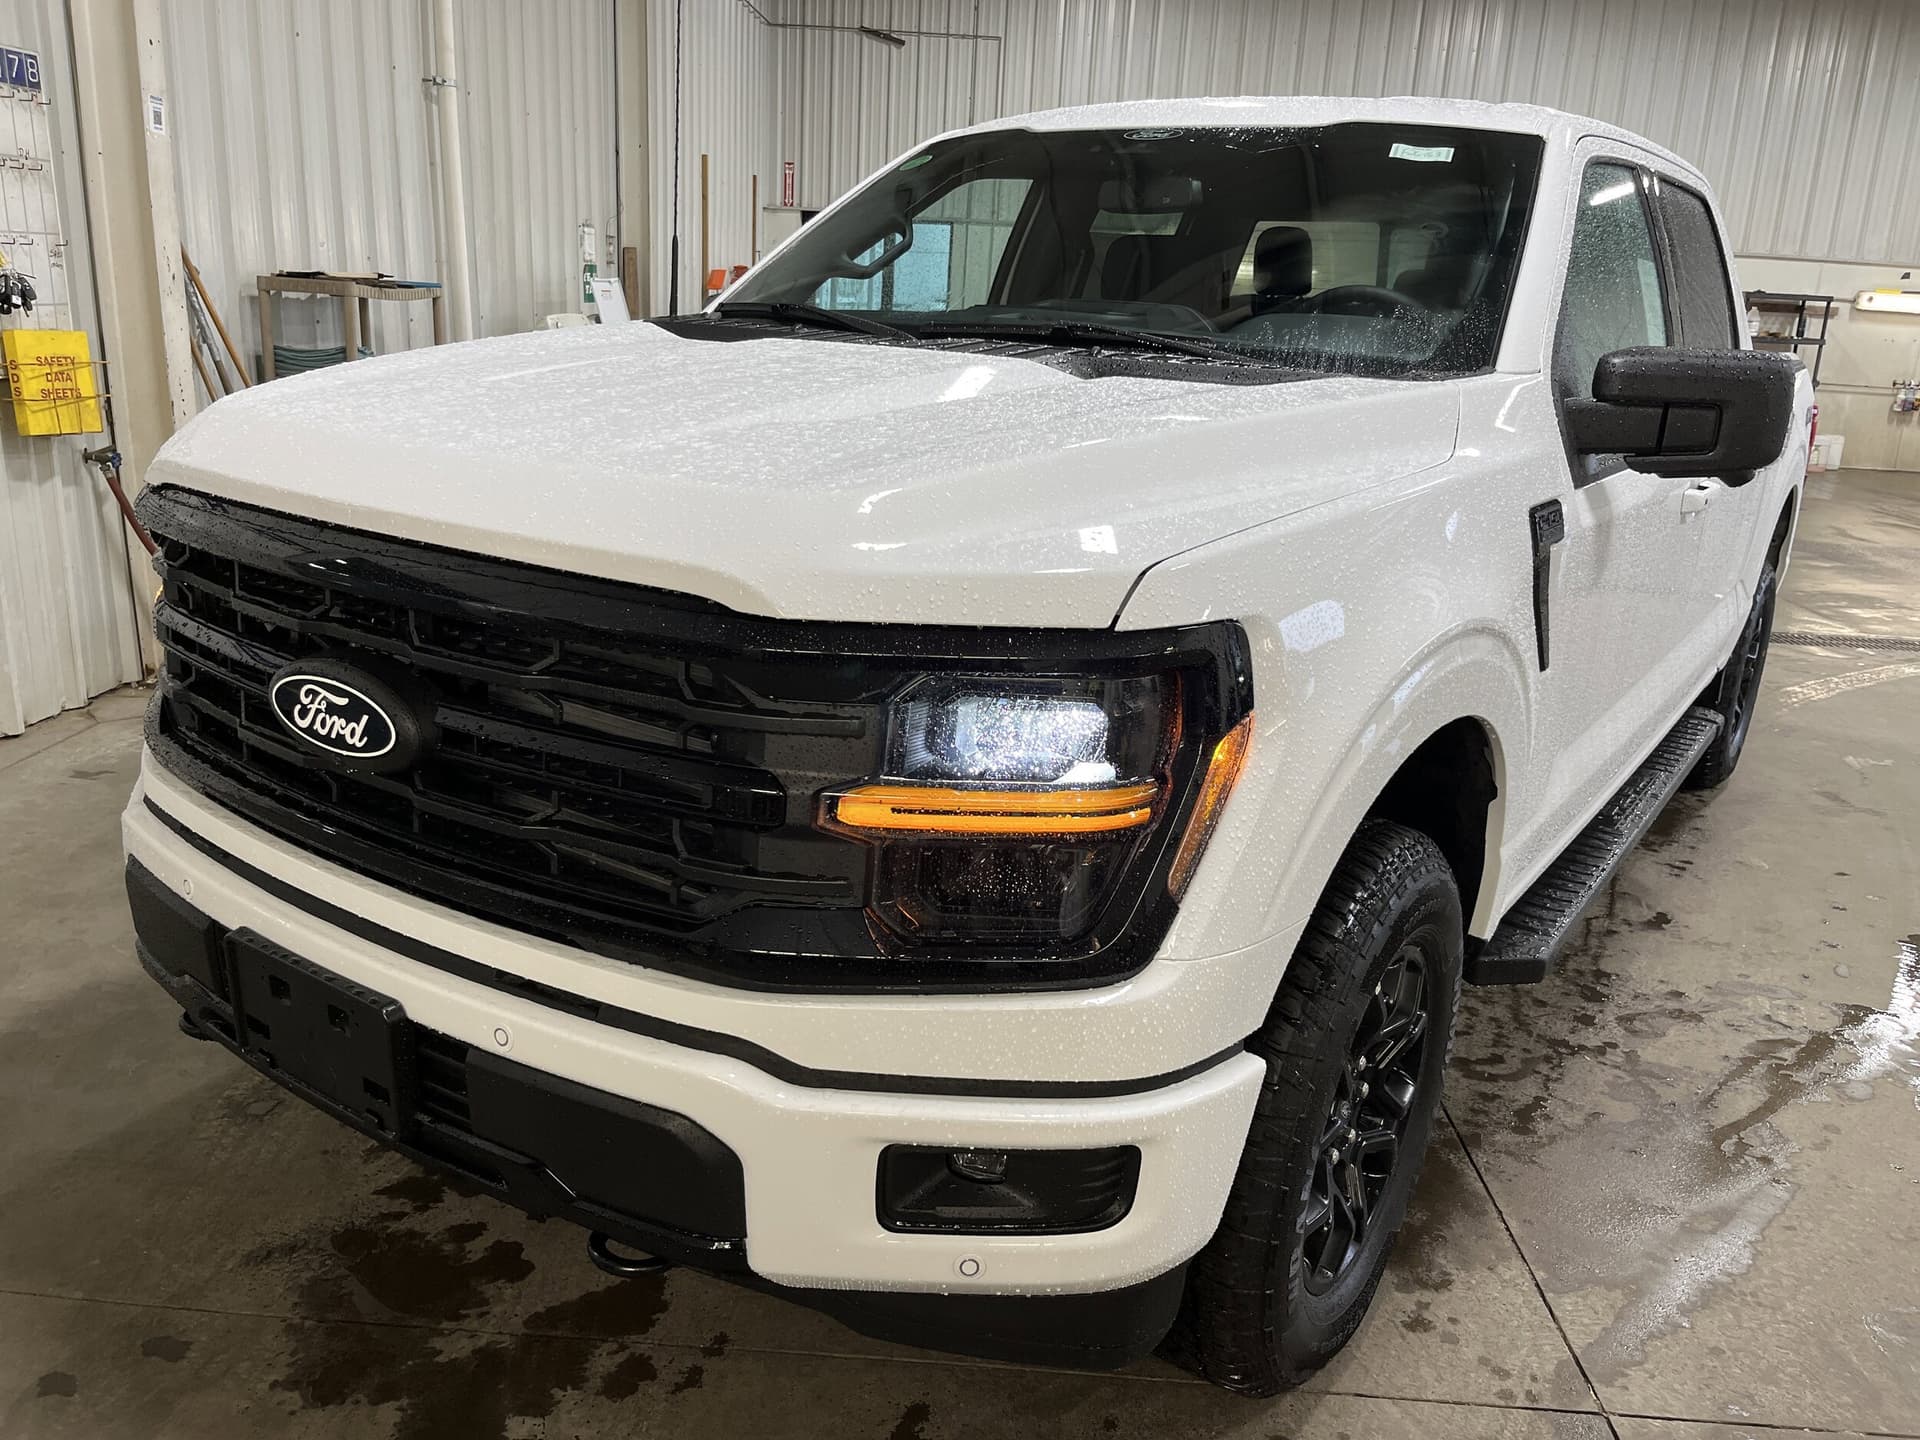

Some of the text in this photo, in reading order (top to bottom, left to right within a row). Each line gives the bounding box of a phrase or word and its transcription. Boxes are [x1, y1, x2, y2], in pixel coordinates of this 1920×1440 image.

[35, 356, 75, 367] SAFETY
[45, 372, 73, 383] DATA
[40, 388, 82, 399] SHEETS
[293, 683, 370, 748] Ford
